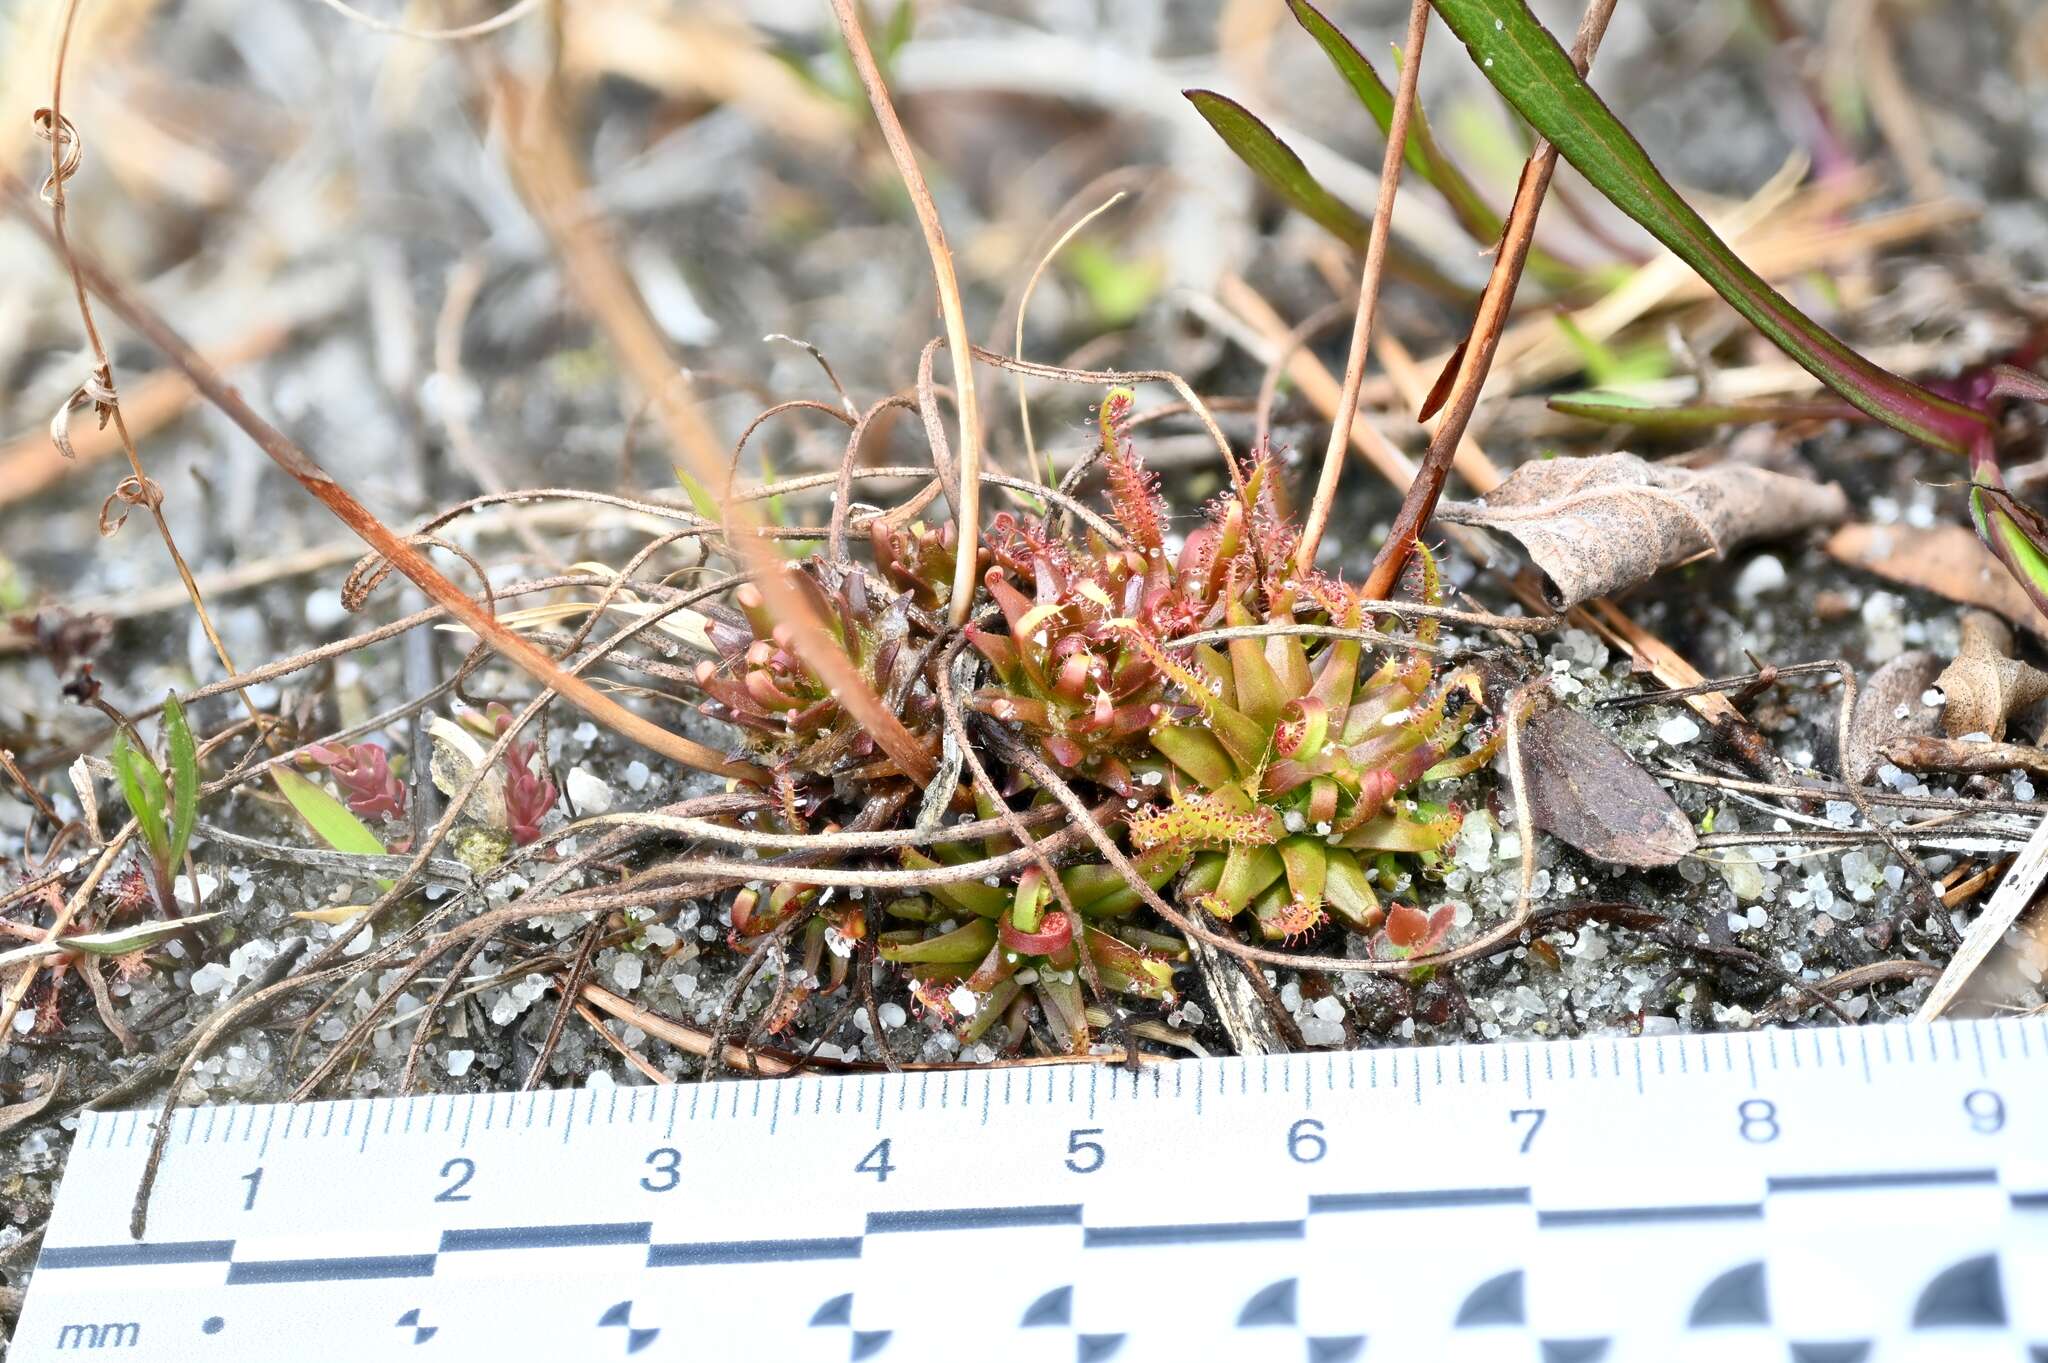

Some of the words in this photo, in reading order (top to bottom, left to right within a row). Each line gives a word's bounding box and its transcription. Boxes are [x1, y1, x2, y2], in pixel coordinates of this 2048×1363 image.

[242, 1166, 264, 1211] 1
[434, 1157, 476, 1203] 2
[639, 1147, 682, 1193] 3
[854, 1137, 897, 1183] 4
[1064, 1127, 1106, 1174] 5
[1287, 1118, 1327, 1164] 6
[1509, 1108, 1547, 1154] 7
[1737, 1098, 1781, 1144] 8
[1962, 1089, 2007, 1135] 9
[56, 1322, 141, 1350] mm
